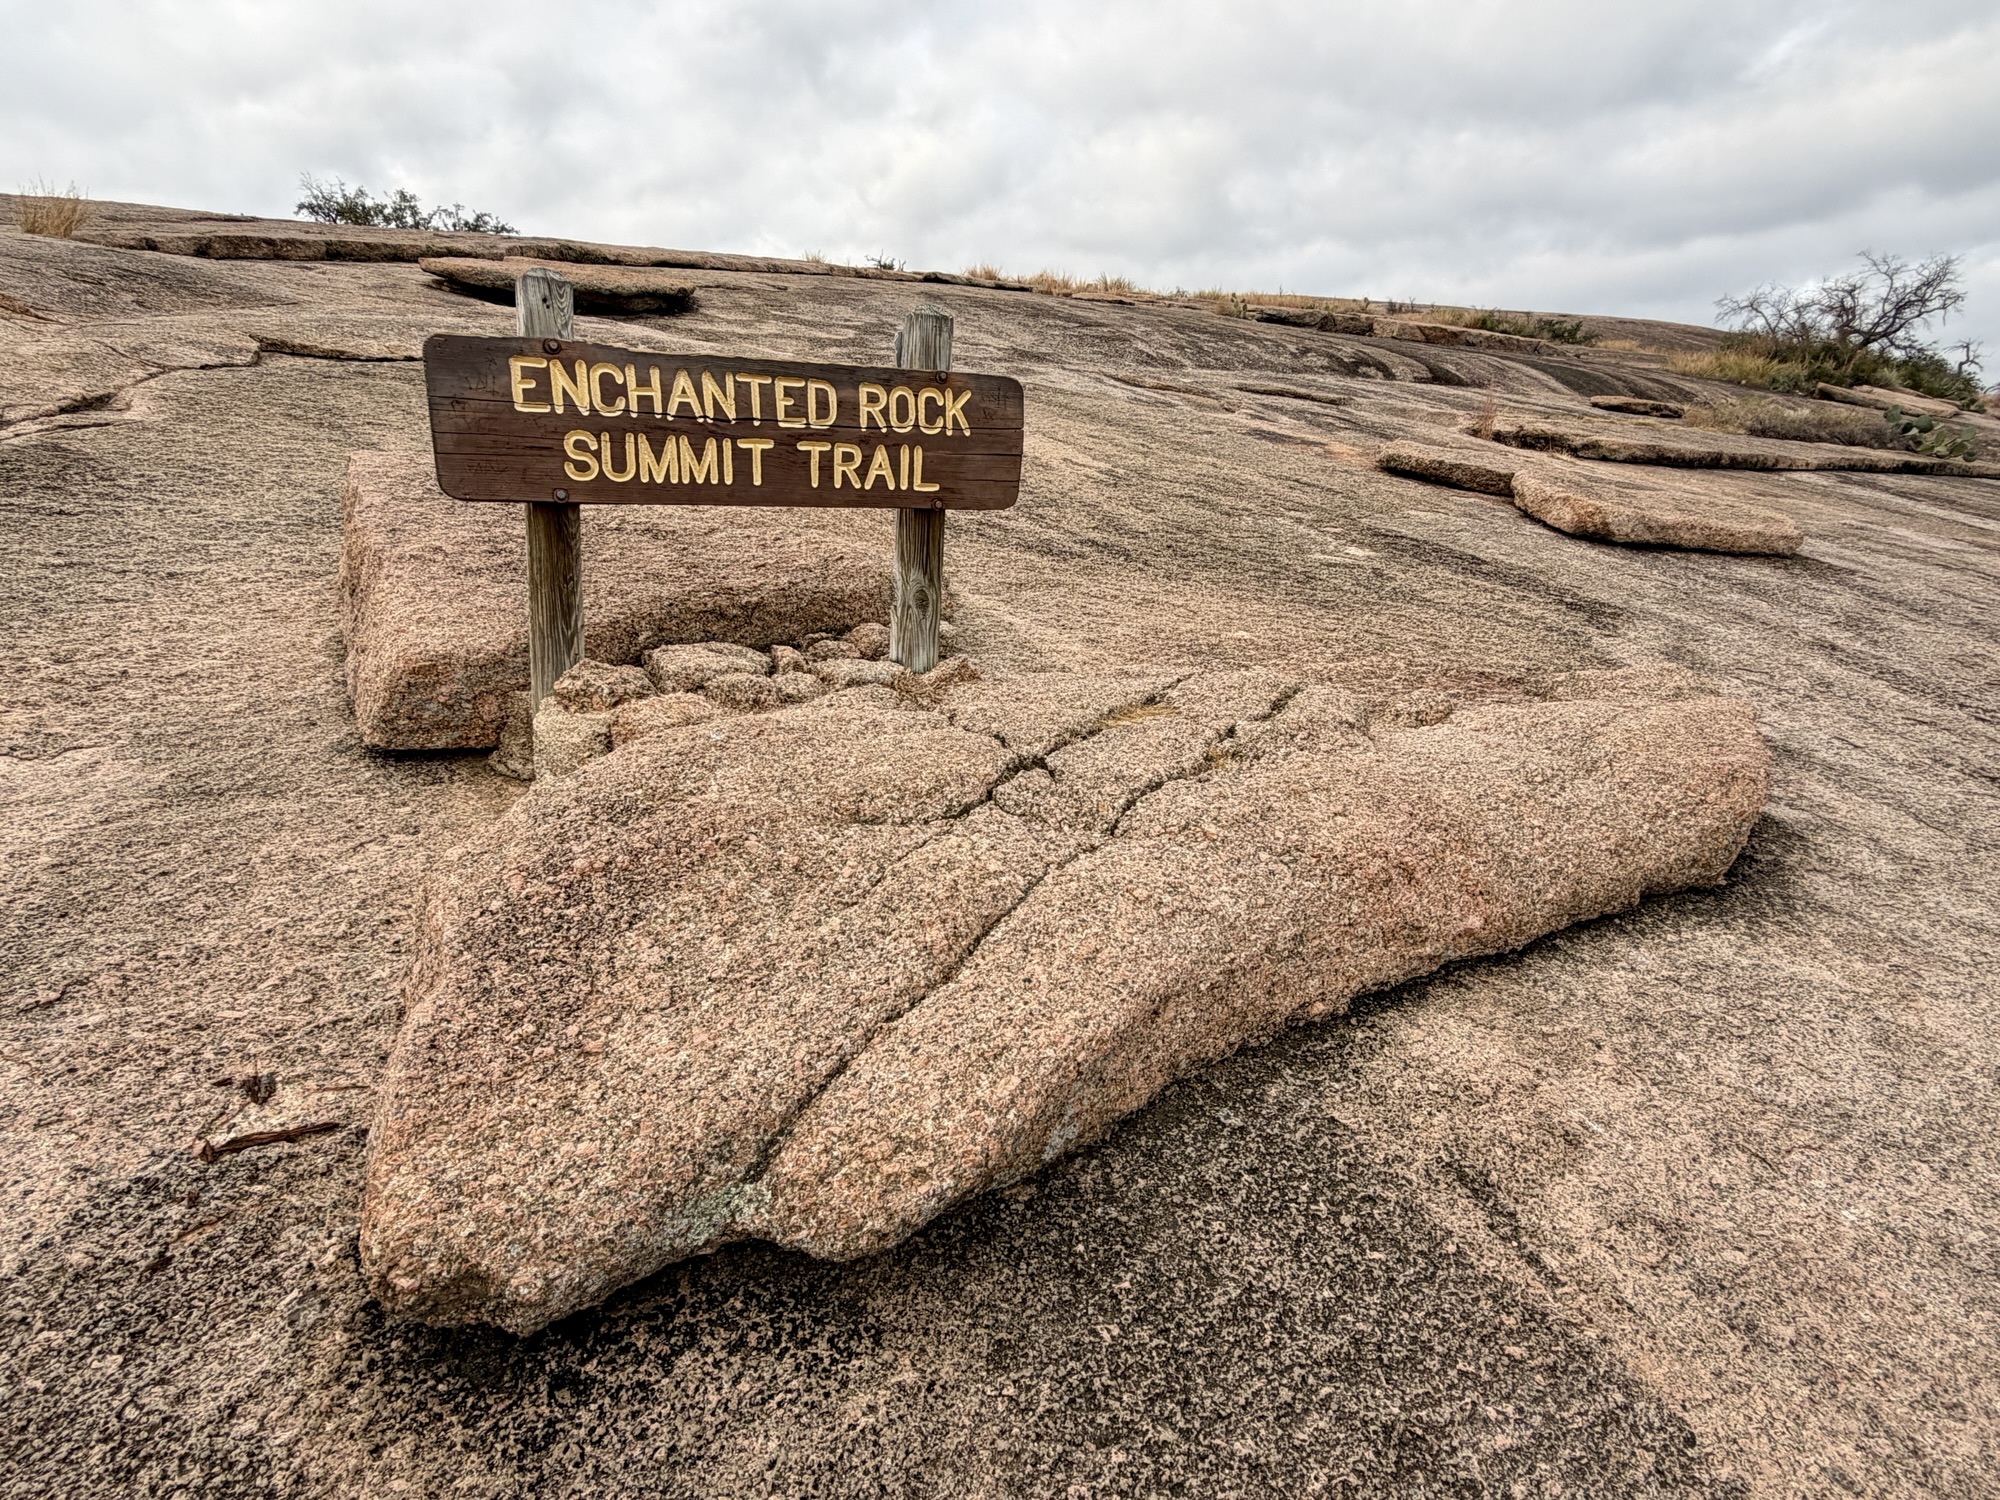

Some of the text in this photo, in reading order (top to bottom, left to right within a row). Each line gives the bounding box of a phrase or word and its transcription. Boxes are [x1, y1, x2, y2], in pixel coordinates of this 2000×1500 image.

[508, 355, 838, 430] ENCHANTED
[858, 382, 972, 437] ROCK
[562, 429, 940, 492] SUMMIT TRAIL
